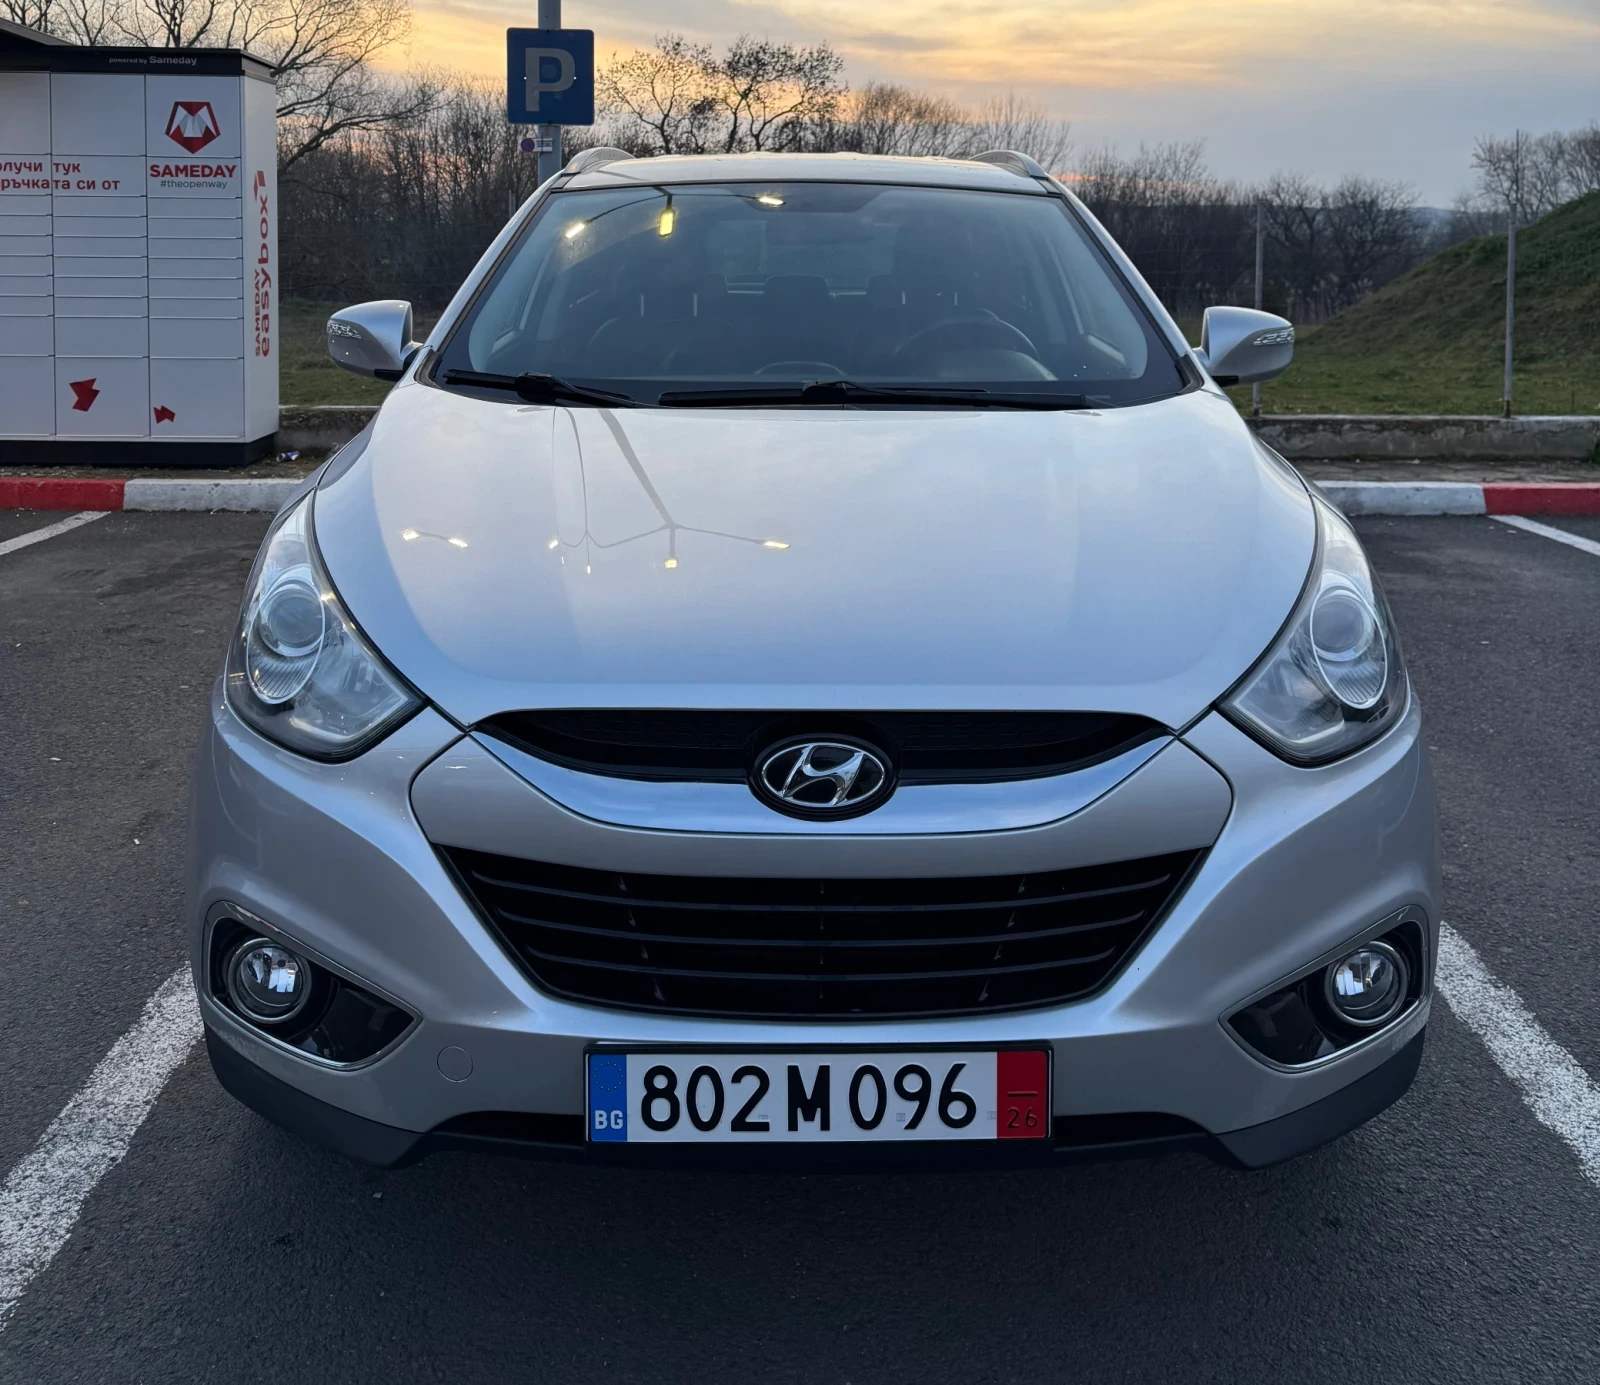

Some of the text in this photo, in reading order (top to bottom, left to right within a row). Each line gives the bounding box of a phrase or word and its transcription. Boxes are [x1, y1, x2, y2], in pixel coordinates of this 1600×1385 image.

[139, 57, 148, 65] by
[149, 55, 197, 66] Sameday
[525, 47, 576, 112] P
[53, 162, 81, 175] тук
[149, 164, 237, 178] SAMEDAY
[76, 180, 96, 190] си
[102, 180, 120, 190] от
[160, 179, 228, 189] #theopenway
[257, 194, 272, 358] easybox
[594, 1109, 624, 1130] BG
[1006, 1106, 1038, 1129] 26
